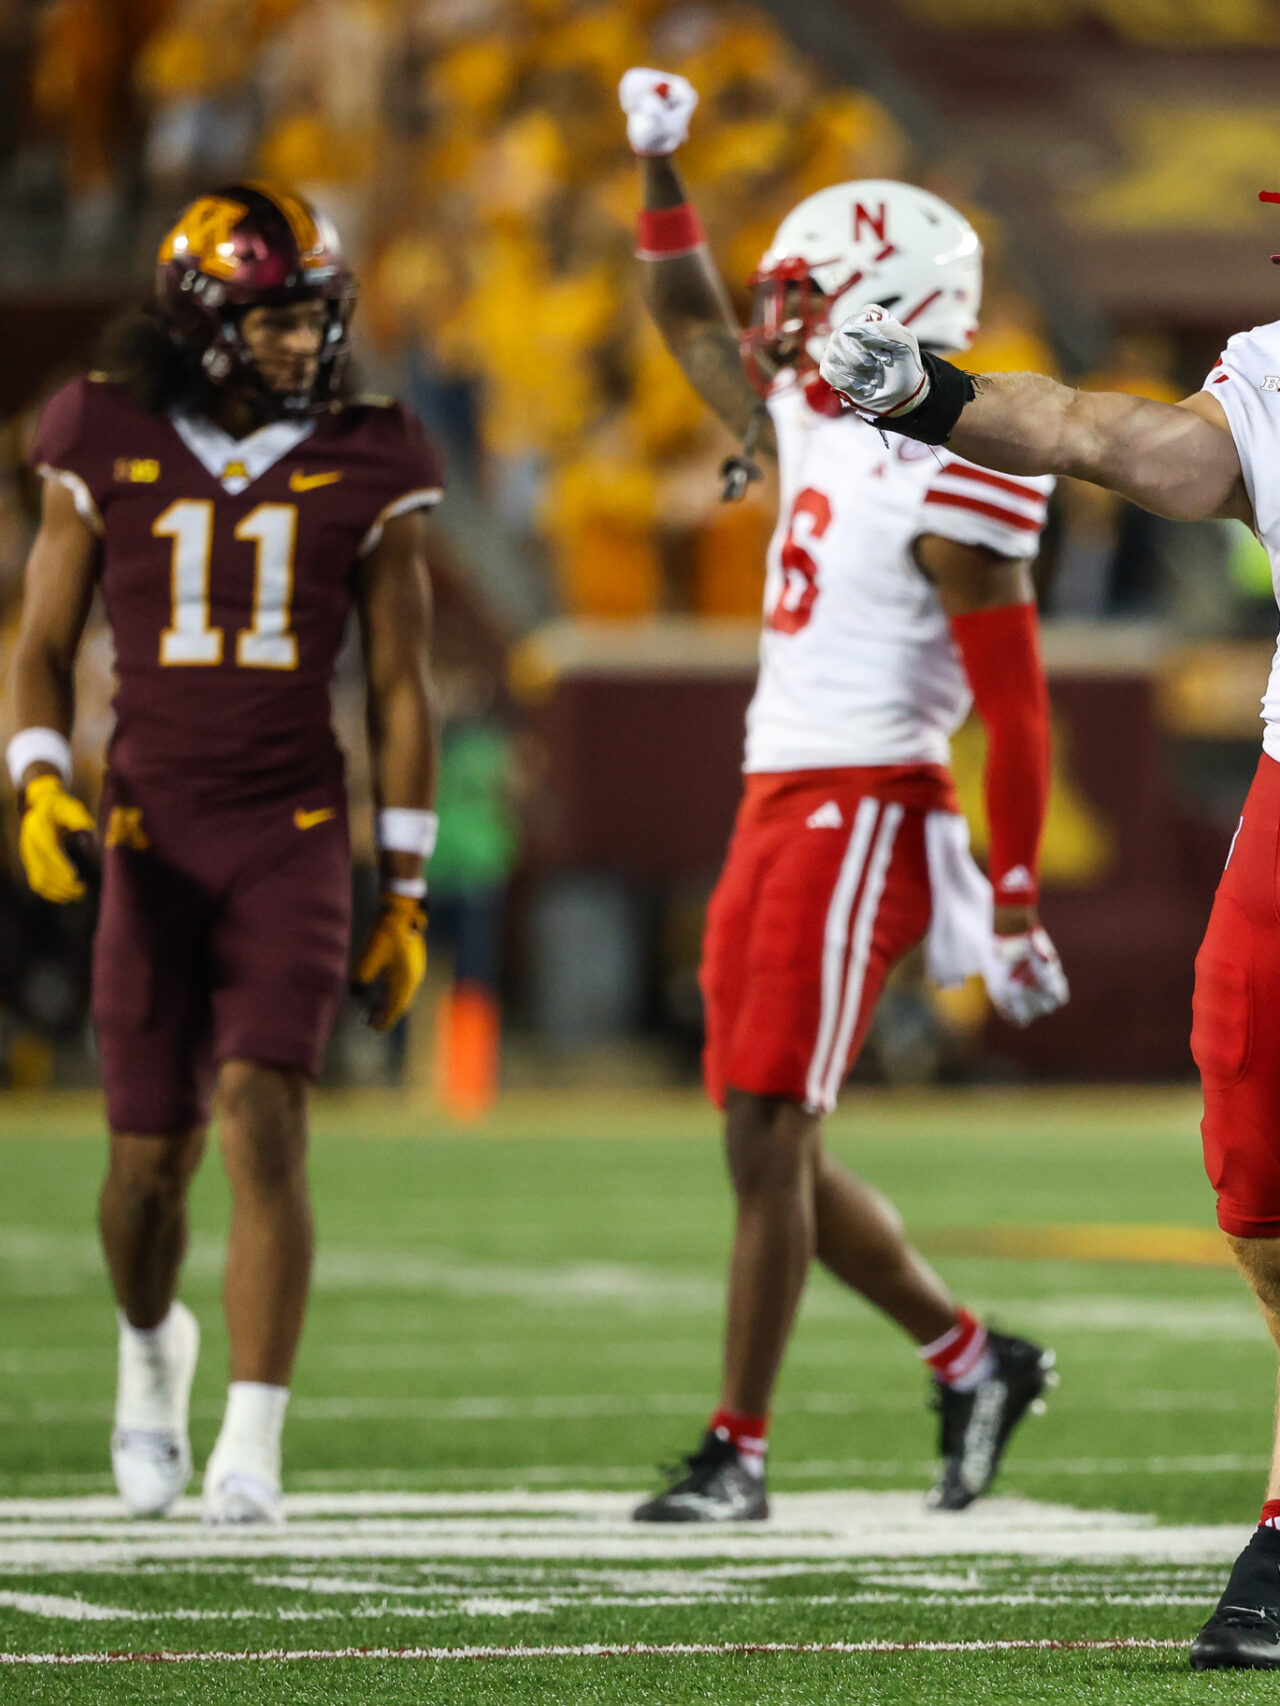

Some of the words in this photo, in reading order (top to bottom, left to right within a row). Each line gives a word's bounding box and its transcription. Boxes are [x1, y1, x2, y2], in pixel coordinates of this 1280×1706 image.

[853, 202, 886, 242] N
[151, 498, 299, 670] 11
[770, 487, 832, 635] 6
